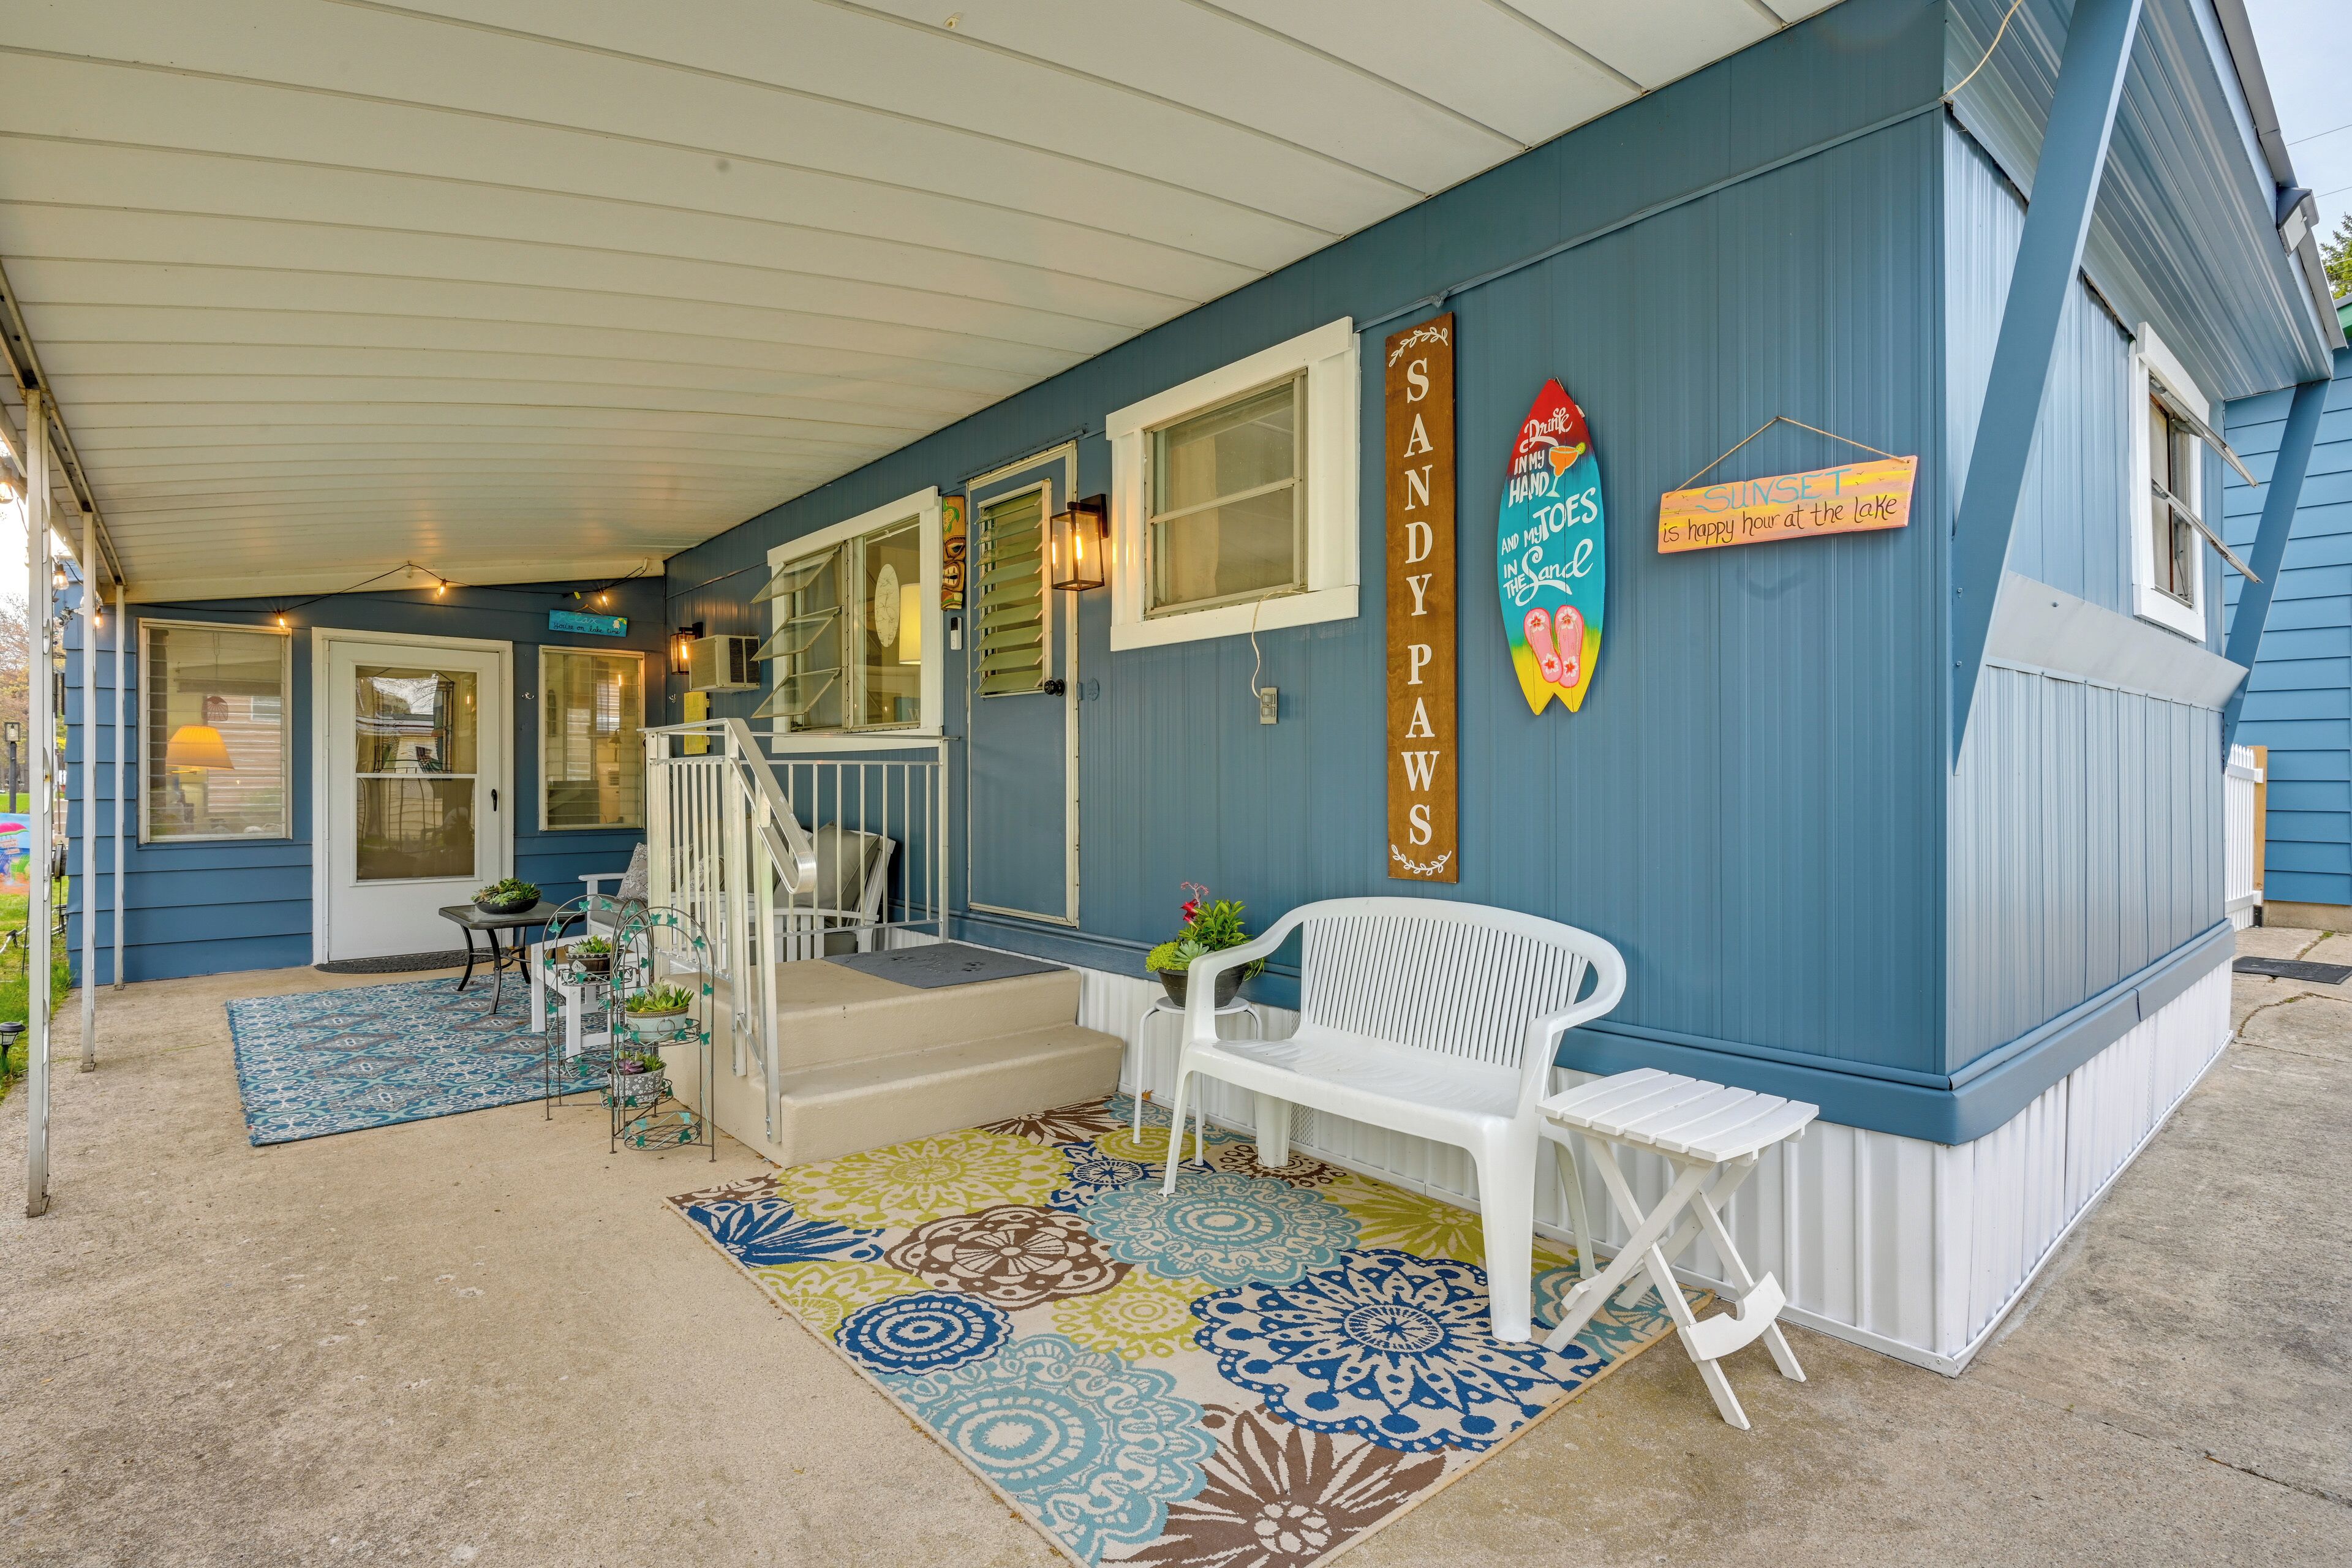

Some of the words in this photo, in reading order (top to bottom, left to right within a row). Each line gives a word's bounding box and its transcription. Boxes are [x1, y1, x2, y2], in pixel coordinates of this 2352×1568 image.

[1519, 407, 1573, 453] Drink
[1513, 455, 1528, 475] IN
[1529, 450, 1545, 471] MY
[1403, 357, 1433, 616] SANDY
[1508, 471, 1550, 508] HAND
[1695, 468, 1852, 513] SUNSET
[1524, 524, 1542, 548] MY
[1532, 487, 1598, 541] TOES
[1664, 522, 1679, 543] is
[1688, 518, 1734, 545] happy
[1743, 511, 1780, 537] hour
[1784, 504, 1806, 529] at
[1810, 501, 1846, 526] the
[1501, 533, 1519, 556] AND
[1502, 573, 1527, 599] THE
[1515, 538, 1594, 607] Sand
[1504, 559, 1518, 578] IN
[1401, 643, 1440, 845] PAWS
